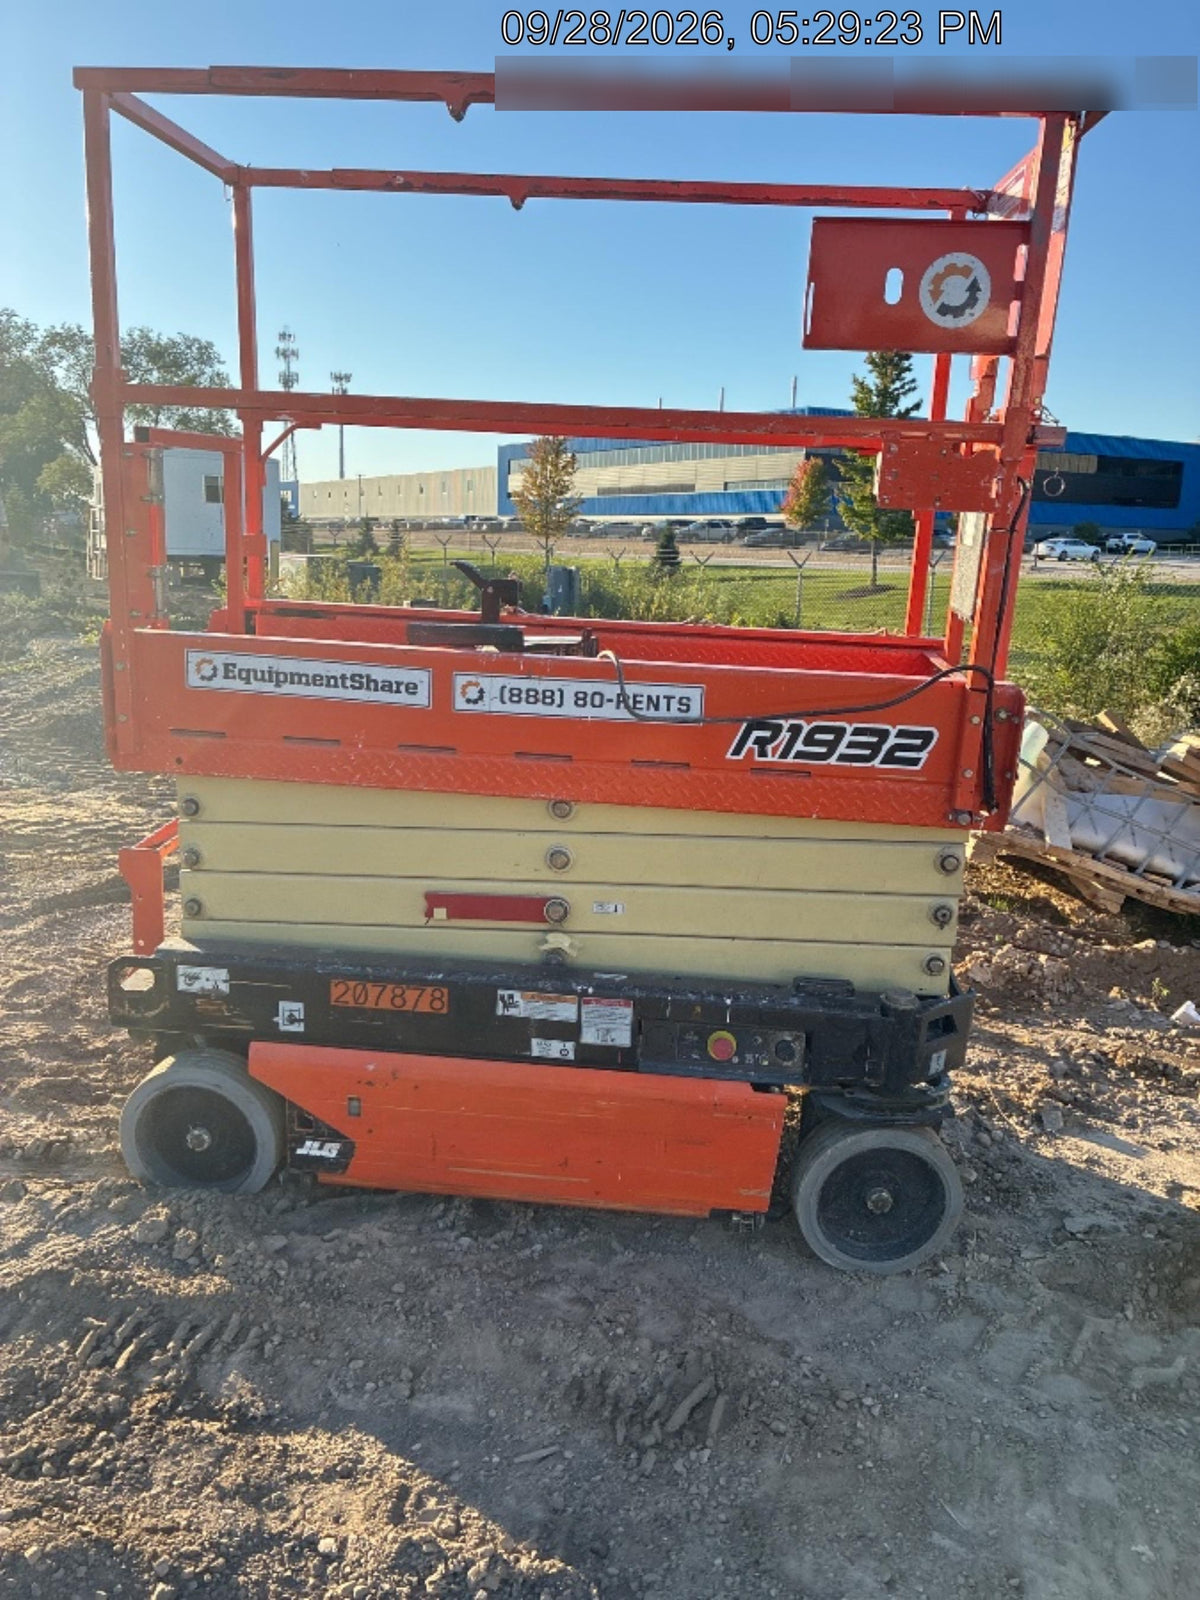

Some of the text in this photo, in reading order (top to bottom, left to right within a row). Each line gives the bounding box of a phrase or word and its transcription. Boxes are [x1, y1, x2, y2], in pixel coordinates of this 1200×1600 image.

[222, 662, 419, 696] EquipmentShare
[499, 685, 565, 708] (888)
[726, 719, 939, 770] R1932
[334, 981, 446, 1012] 207878
[295, 1139, 342, 1159] JLG
